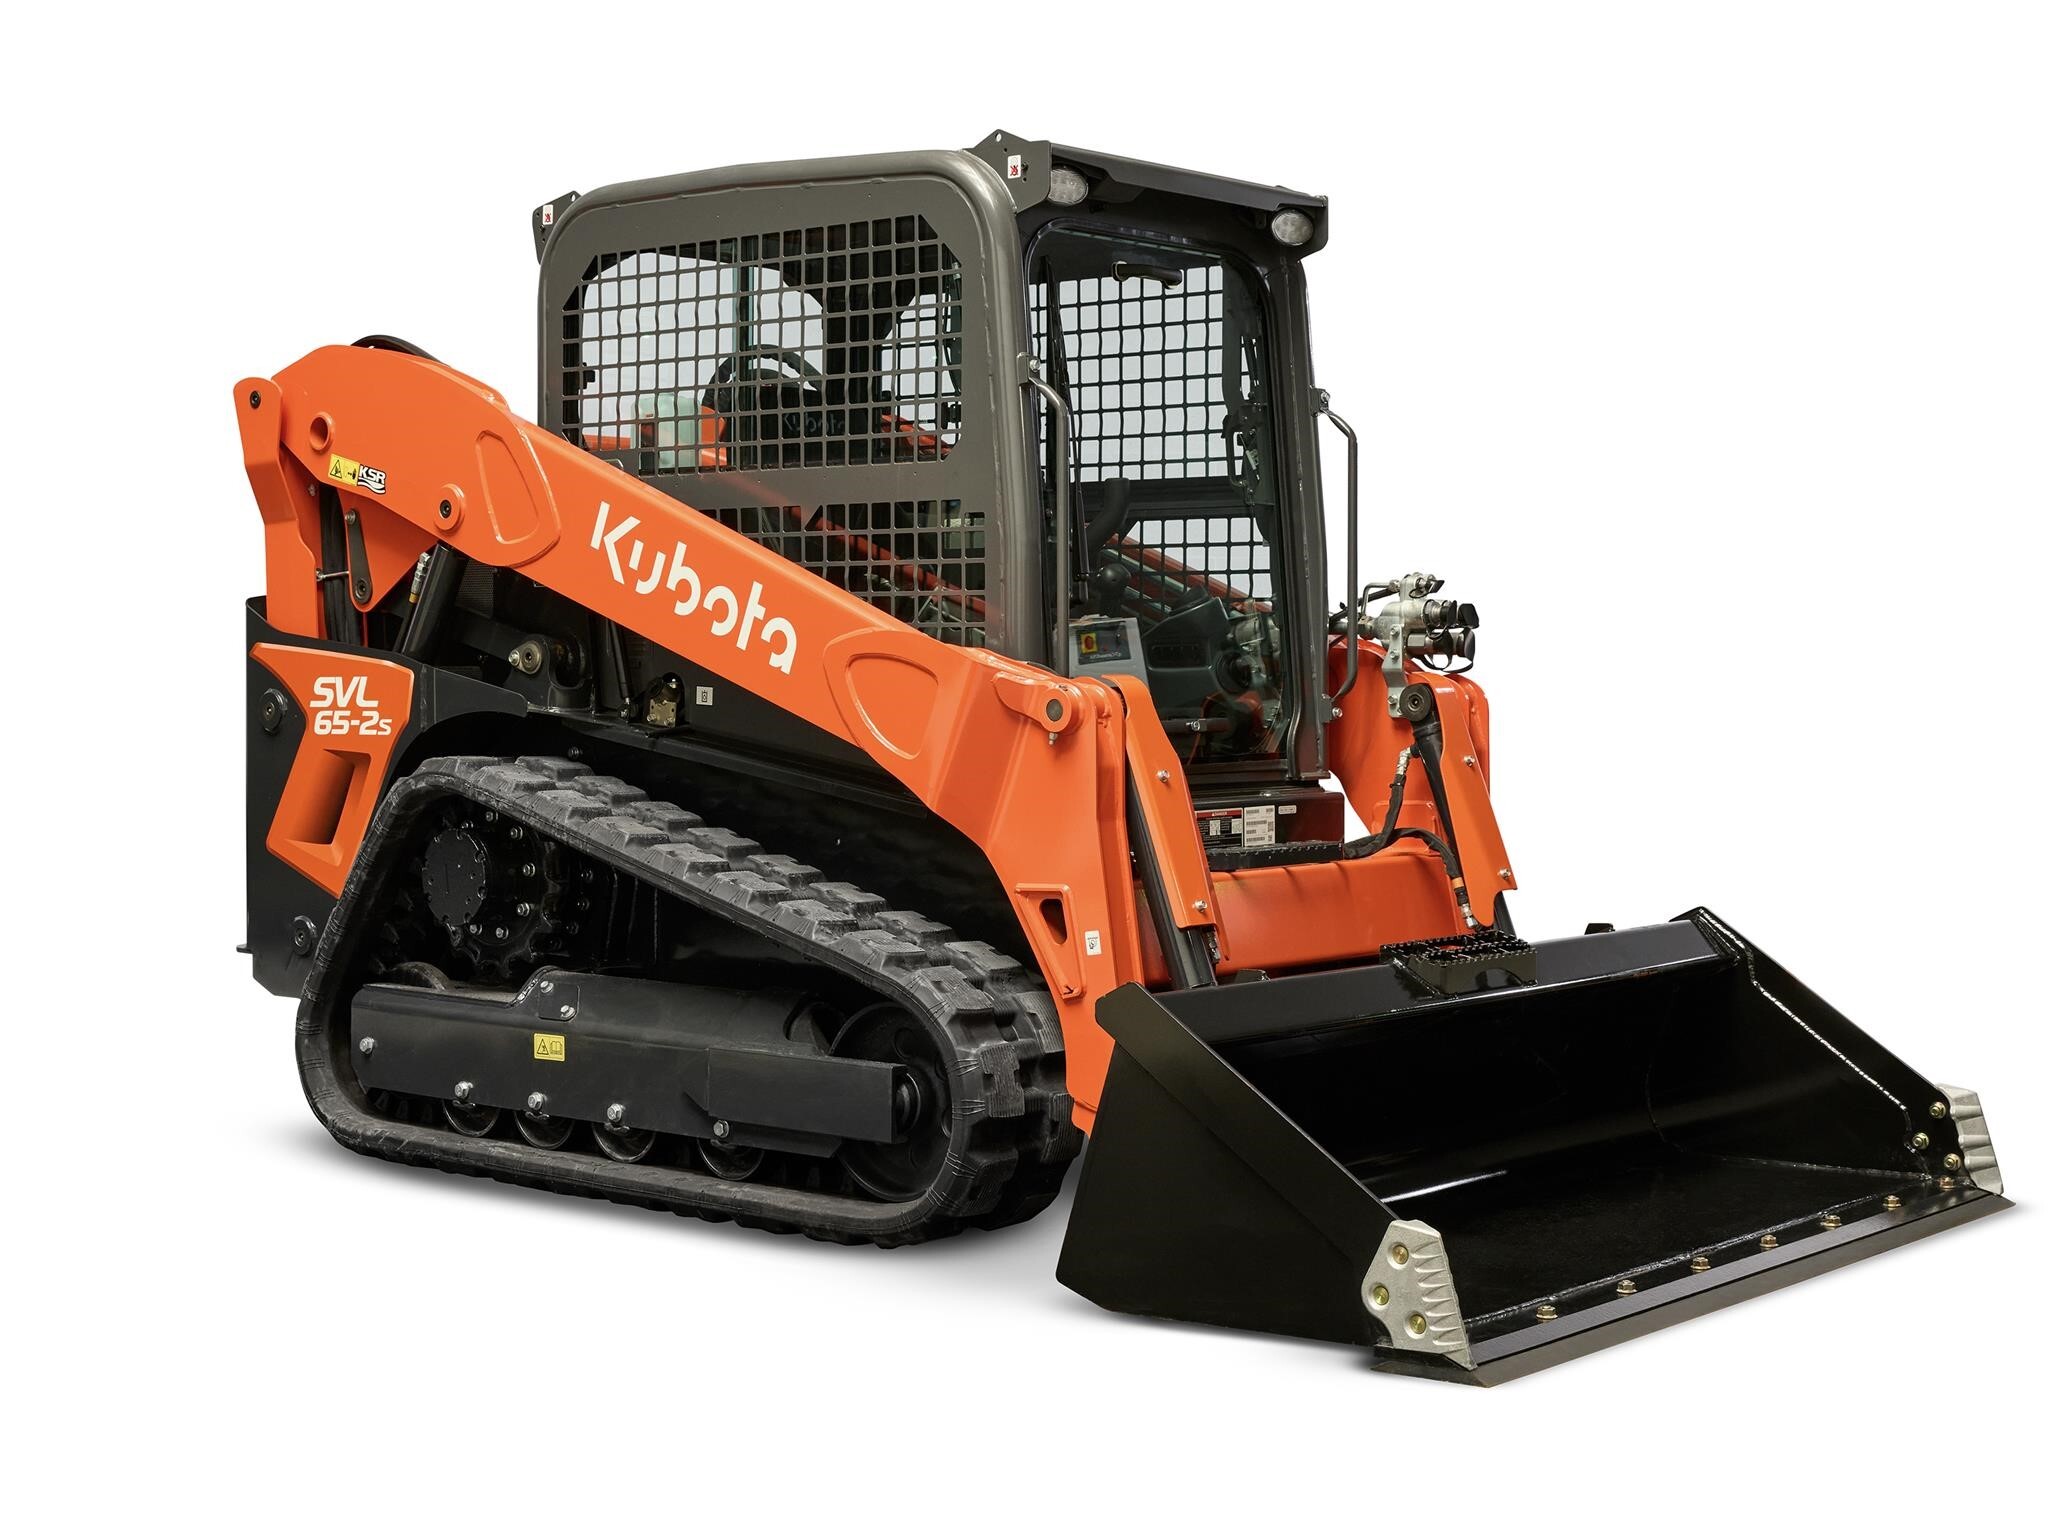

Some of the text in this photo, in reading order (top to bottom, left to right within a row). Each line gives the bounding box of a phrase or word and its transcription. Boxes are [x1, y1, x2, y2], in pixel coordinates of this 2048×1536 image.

[359, 465, 386, 485] KSR
[590, 500, 797, 675] Kubota
[309, 676, 379, 708] SVL
[313, 710, 393, 736] 65-2s
